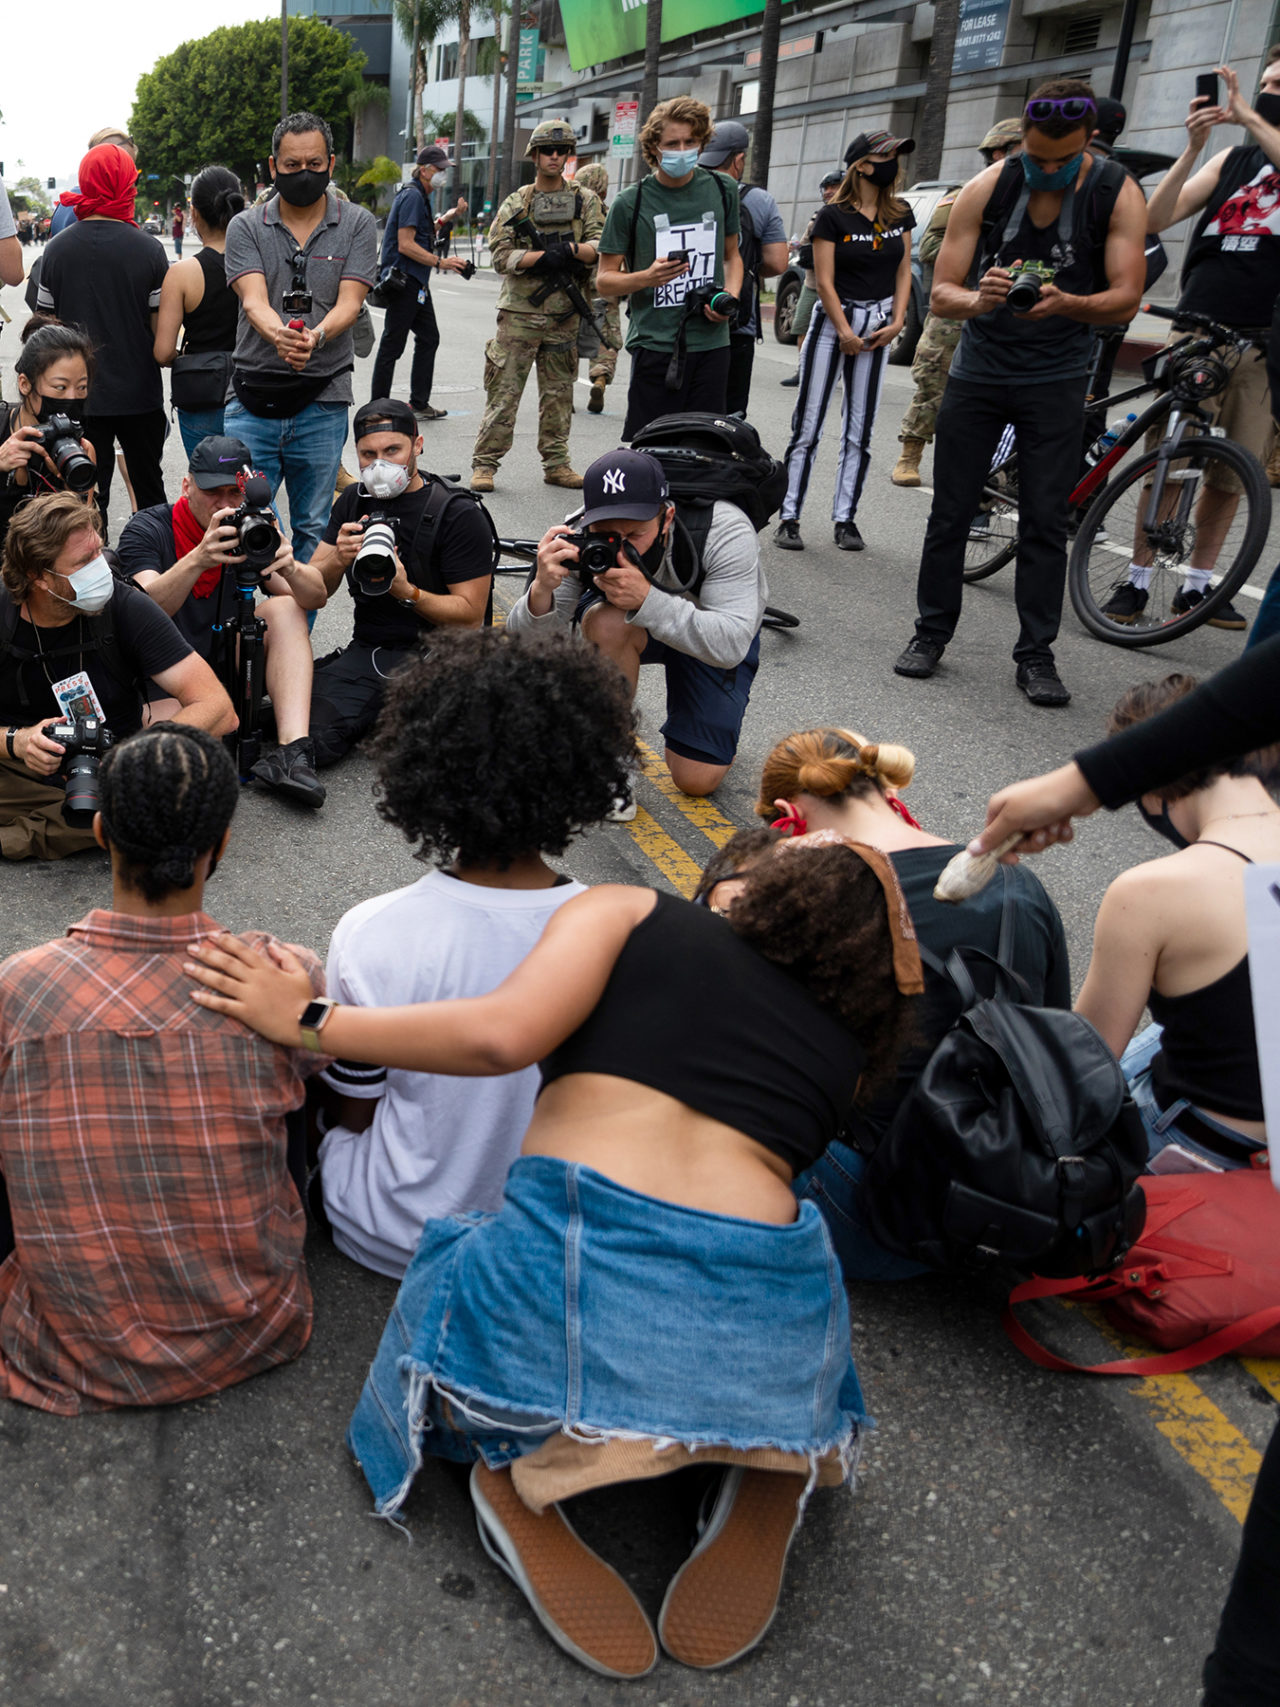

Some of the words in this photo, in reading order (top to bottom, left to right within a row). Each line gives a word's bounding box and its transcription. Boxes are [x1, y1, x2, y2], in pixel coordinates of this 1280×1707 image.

[961, 17, 973, 32] FOR
[973, 13, 997, 29] LEASE
[518, 34, 534, 79] PARK
[55, 677, 83, 694] PRESS
